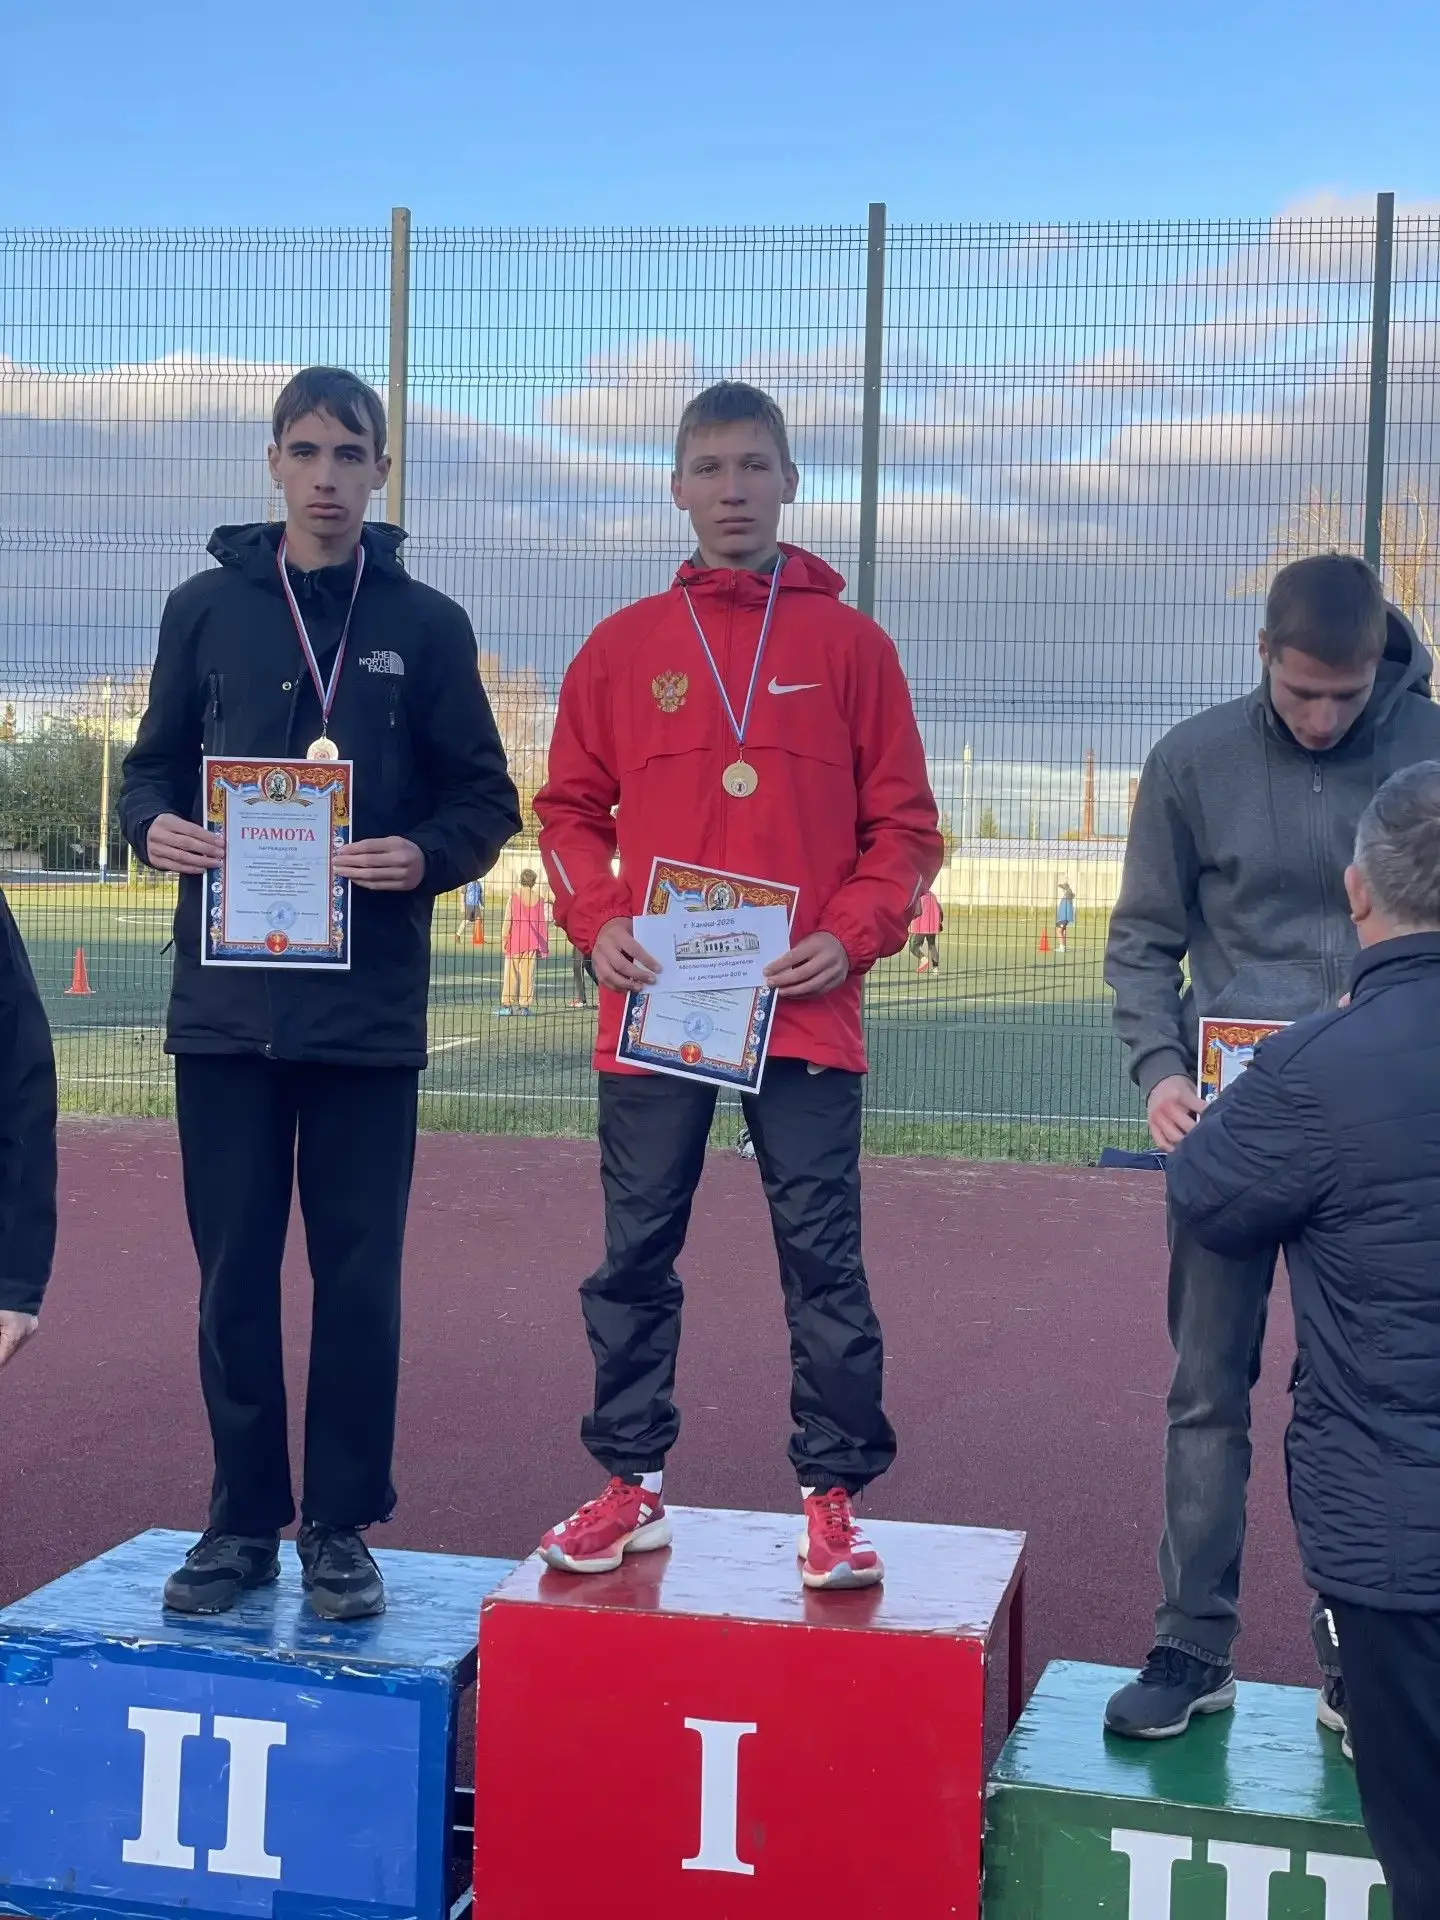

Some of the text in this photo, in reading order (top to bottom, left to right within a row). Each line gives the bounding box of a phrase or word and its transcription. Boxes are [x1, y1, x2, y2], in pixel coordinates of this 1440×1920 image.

[371, 651, 389, 659] THE
[359, 658, 389, 666] NORTH
[368, 665, 390, 673] FACE
[240, 826, 316, 842] ГРАМОТА
[122, 1706, 287, 1880] II
[682, 1717, 757, 1876] I
